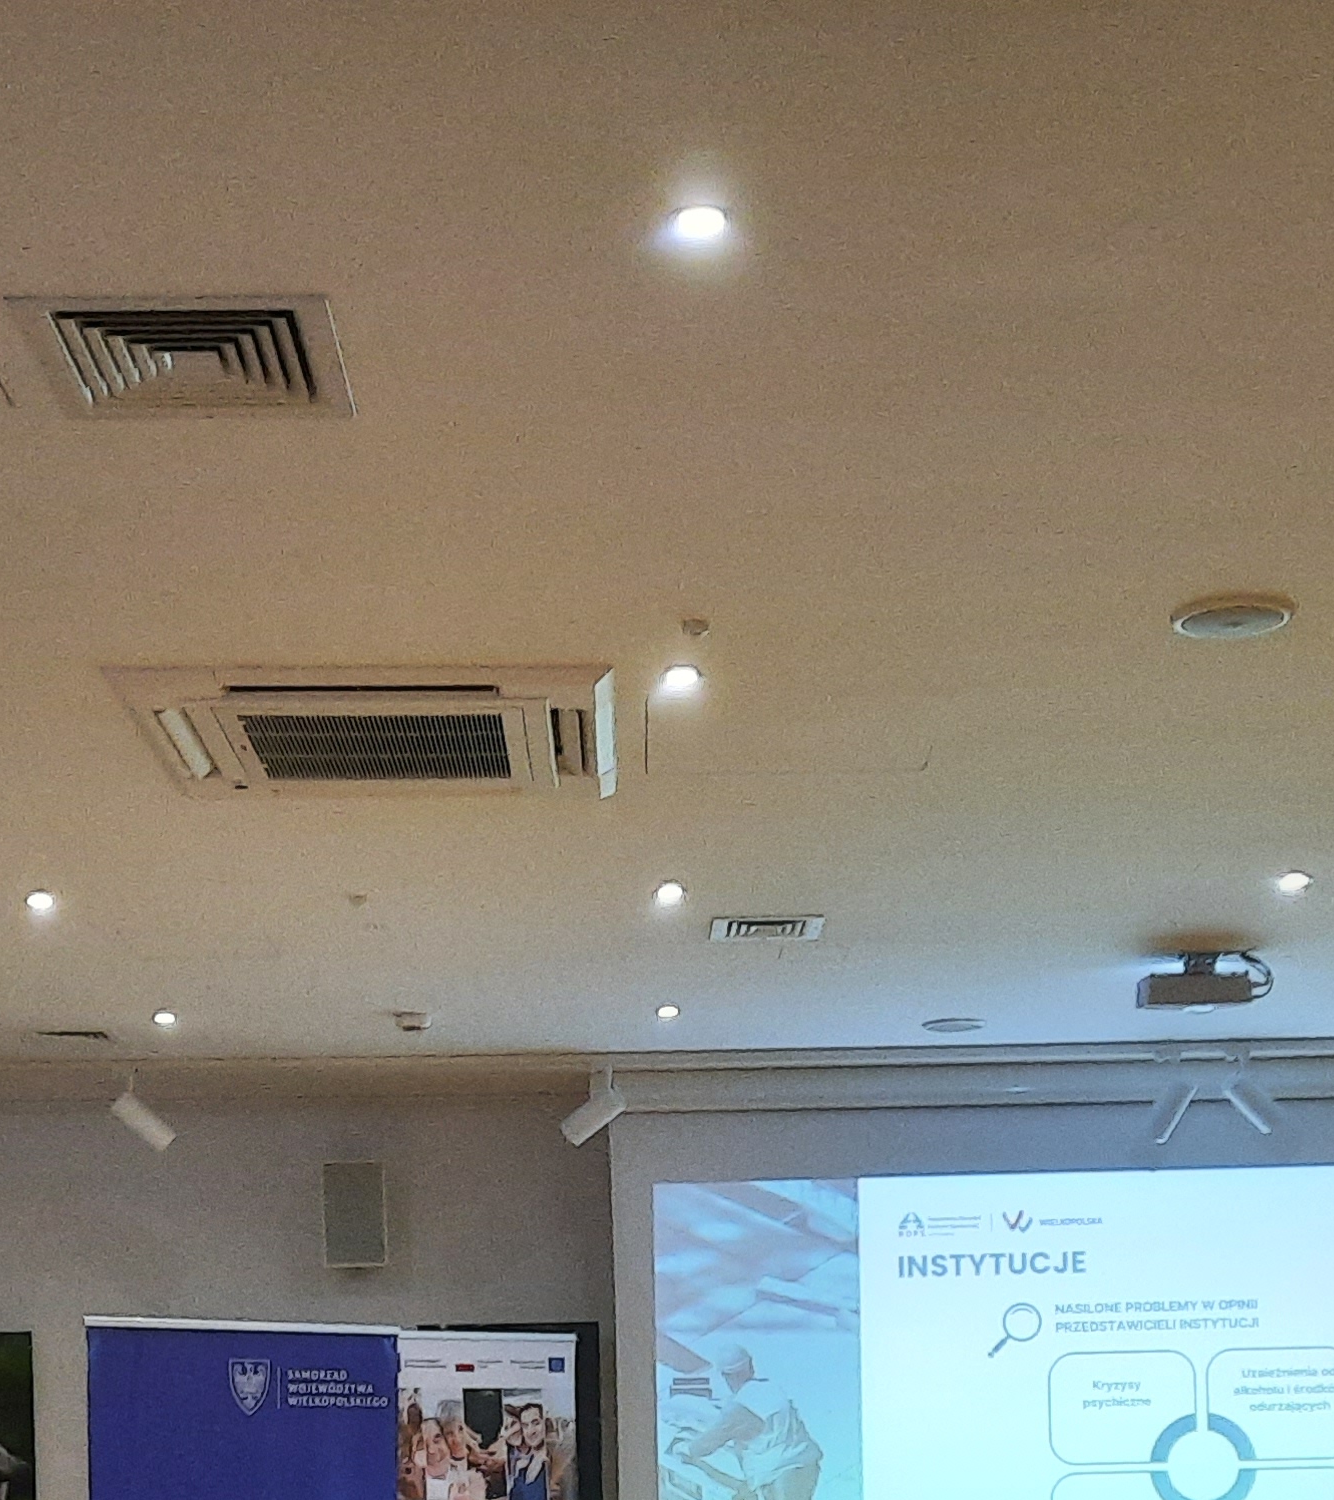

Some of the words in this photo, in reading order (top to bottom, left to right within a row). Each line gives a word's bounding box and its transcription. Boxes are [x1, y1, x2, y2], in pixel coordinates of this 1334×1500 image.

[898, 1250, 1086, 1278] INSTYTUCJE
[1125, 1301, 1198, 1313] PROBLEMY
[1202, 1300, 1215, 1311] W
[1055, 1319, 1176, 1333] PRZEDSTAWICIELI
[1180, 1317, 1260, 1330] INSTYTUCJI
[1092, 1380, 1141, 1394] Kryzysy
[287, 1395, 389, 1407] WIELKOPOLSKIEGO
